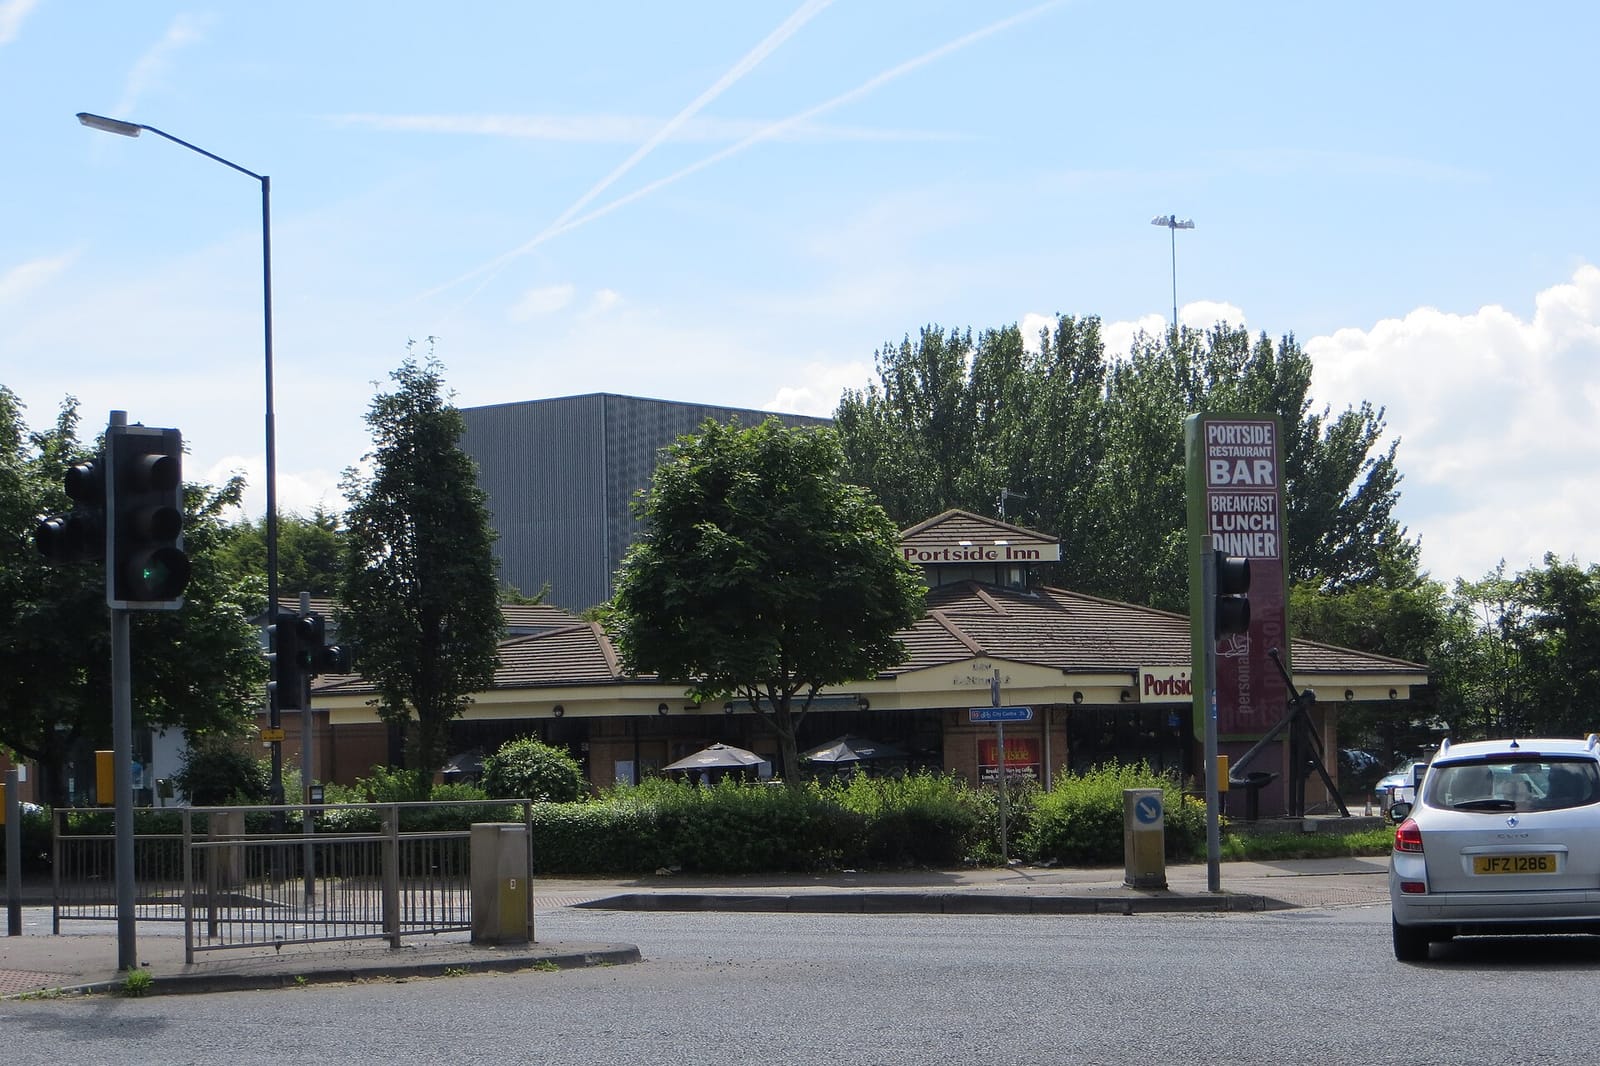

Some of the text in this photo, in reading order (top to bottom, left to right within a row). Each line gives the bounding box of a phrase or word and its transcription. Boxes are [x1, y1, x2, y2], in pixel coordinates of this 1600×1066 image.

[1208, 425, 1272, 444] PORTSIDE
[1209, 446, 1272, 457] RESTAURANT
[1210, 459, 1273, 485] BAR
[1211, 495, 1274, 512] BREAKFAST
[1211, 514, 1275, 531] LUNCH
[1212, 533, 1276, 557] DINNER
[904, 547, 1040, 561] Portside Inn
[1482, 857, 1547, 872] JFZ 1286
